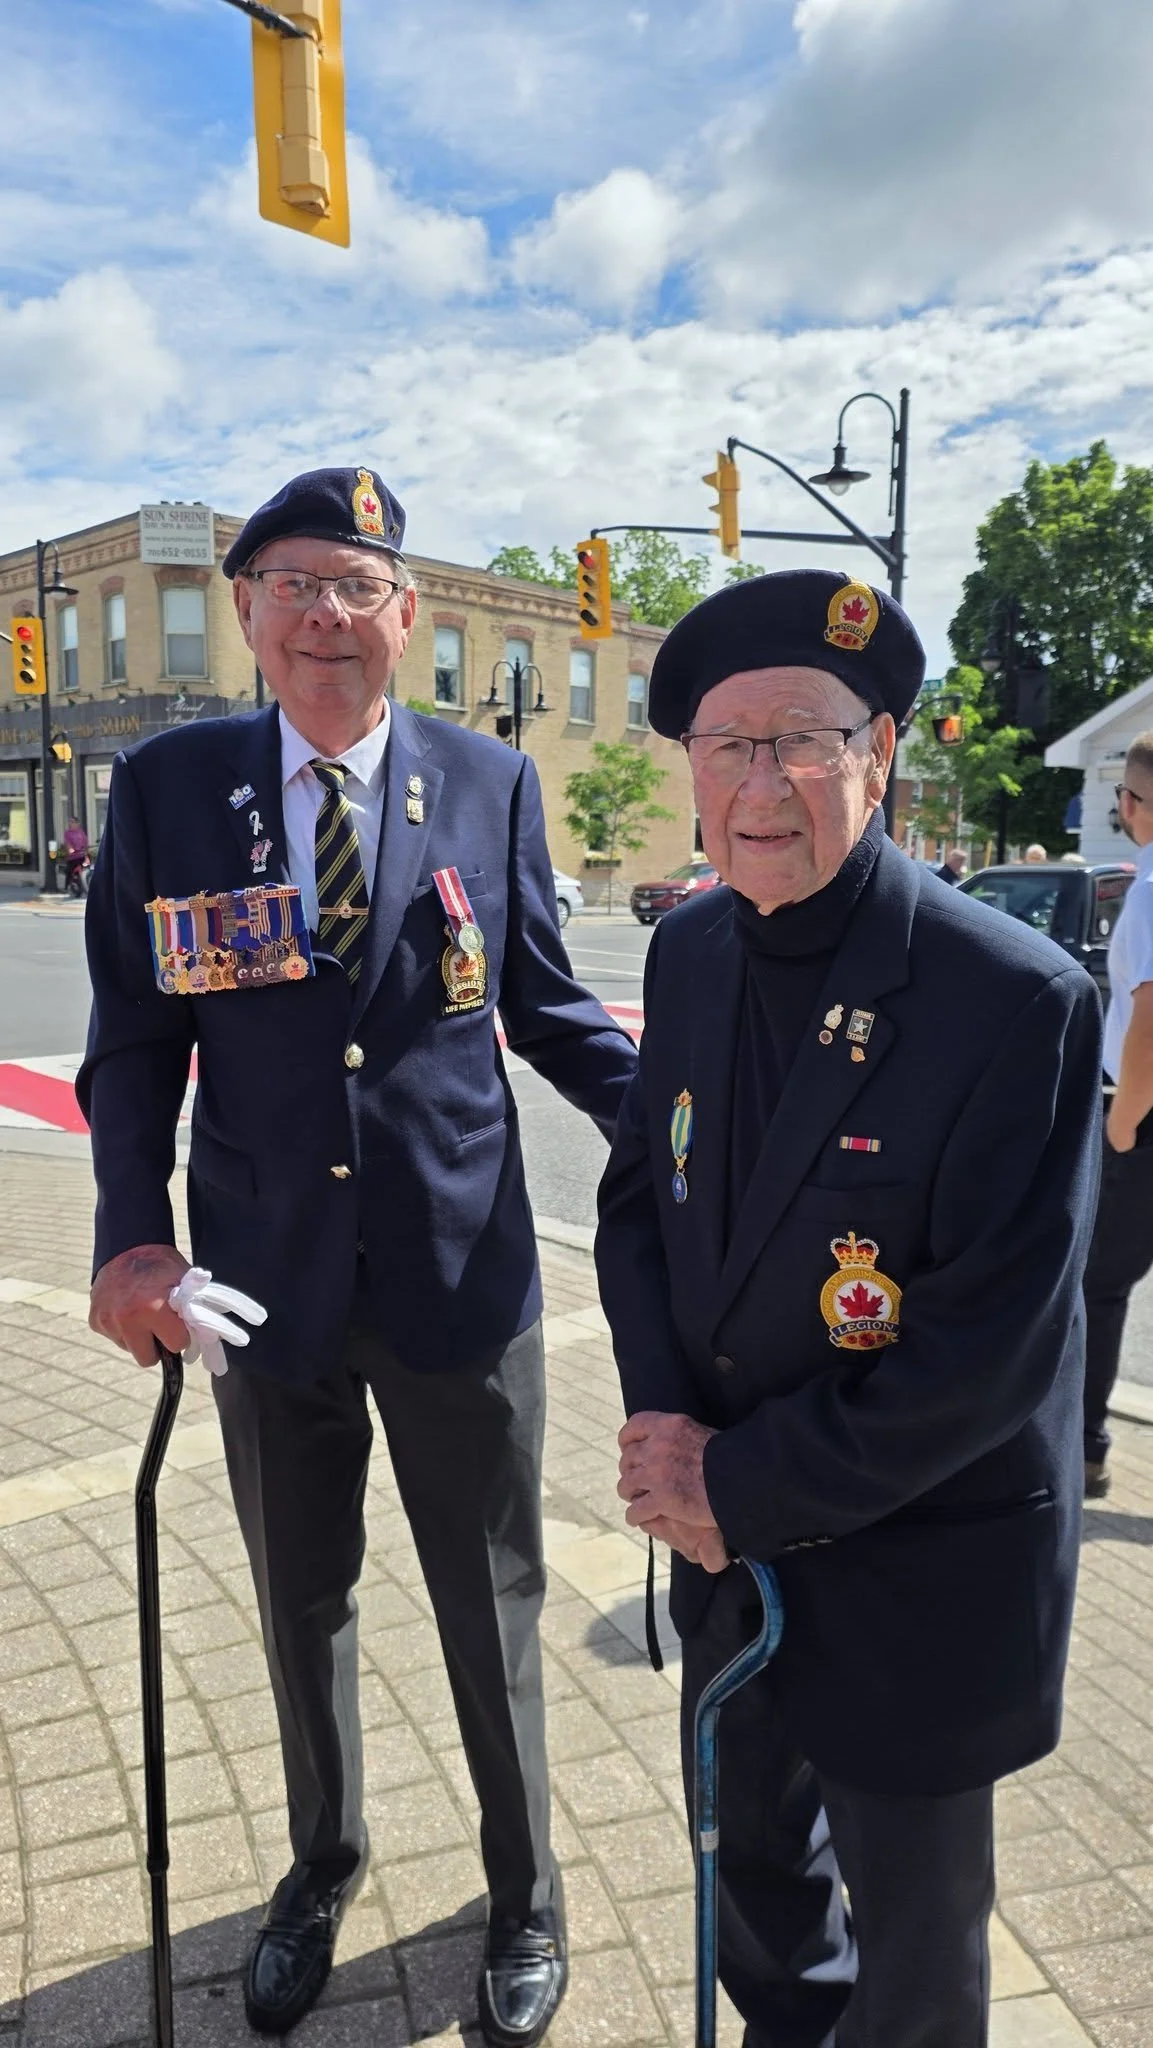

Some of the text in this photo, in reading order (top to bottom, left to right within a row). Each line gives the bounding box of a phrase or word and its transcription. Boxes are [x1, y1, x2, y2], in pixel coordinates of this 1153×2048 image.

[144, 511, 209, 523] SUN SHRINE
[832, 623, 868, 638] LEGION
[451, 980, 483, 993] LEGION
[445, 999, 485, 1013] LIFE MEMBER
[838, 1320, 895, 1335] LEGION
